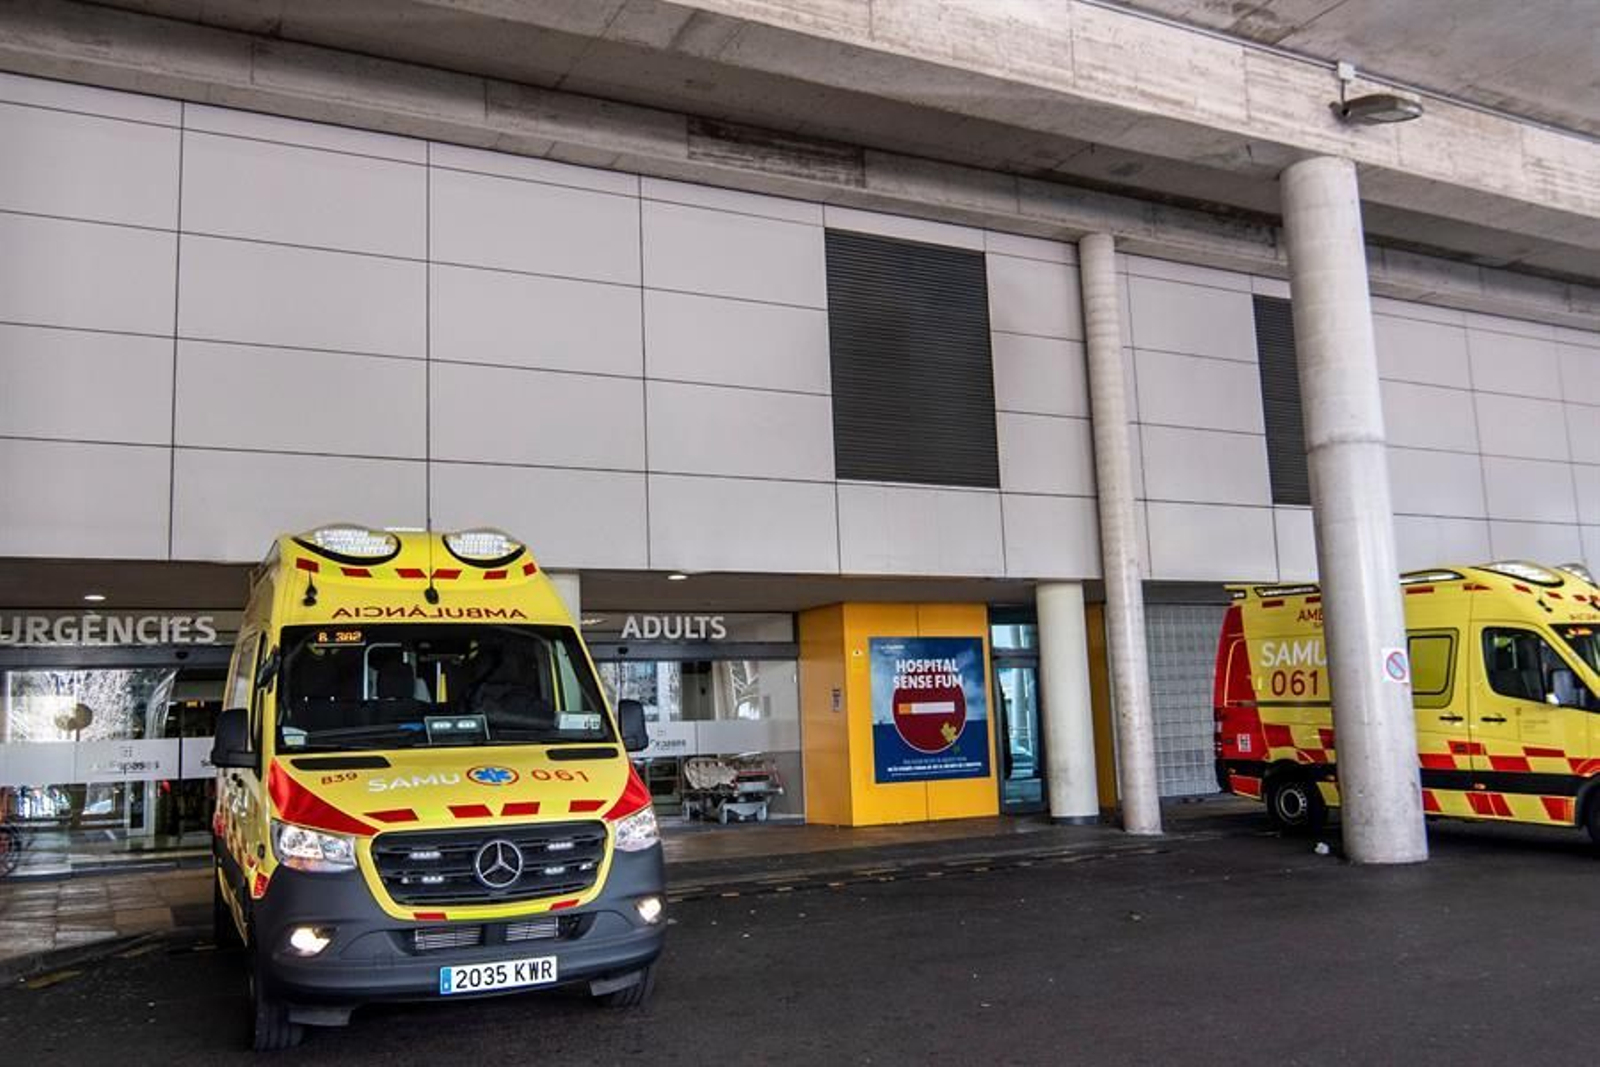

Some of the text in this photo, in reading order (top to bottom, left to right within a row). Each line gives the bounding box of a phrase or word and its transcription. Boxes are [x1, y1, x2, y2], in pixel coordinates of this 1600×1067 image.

[0, 611, 216, 644] URGÈNCIES
[621, 616, 726, 639] ADULTS
[895, 658, 959, 673] HOSPITAL
[893, 674, 963, 690] SENSE FUM
[1272, 669, 1318, 696] 061
[321, 769, 589, 793] 839 SAMU 061
[456, 959, 552, 989] 2035 KWR
